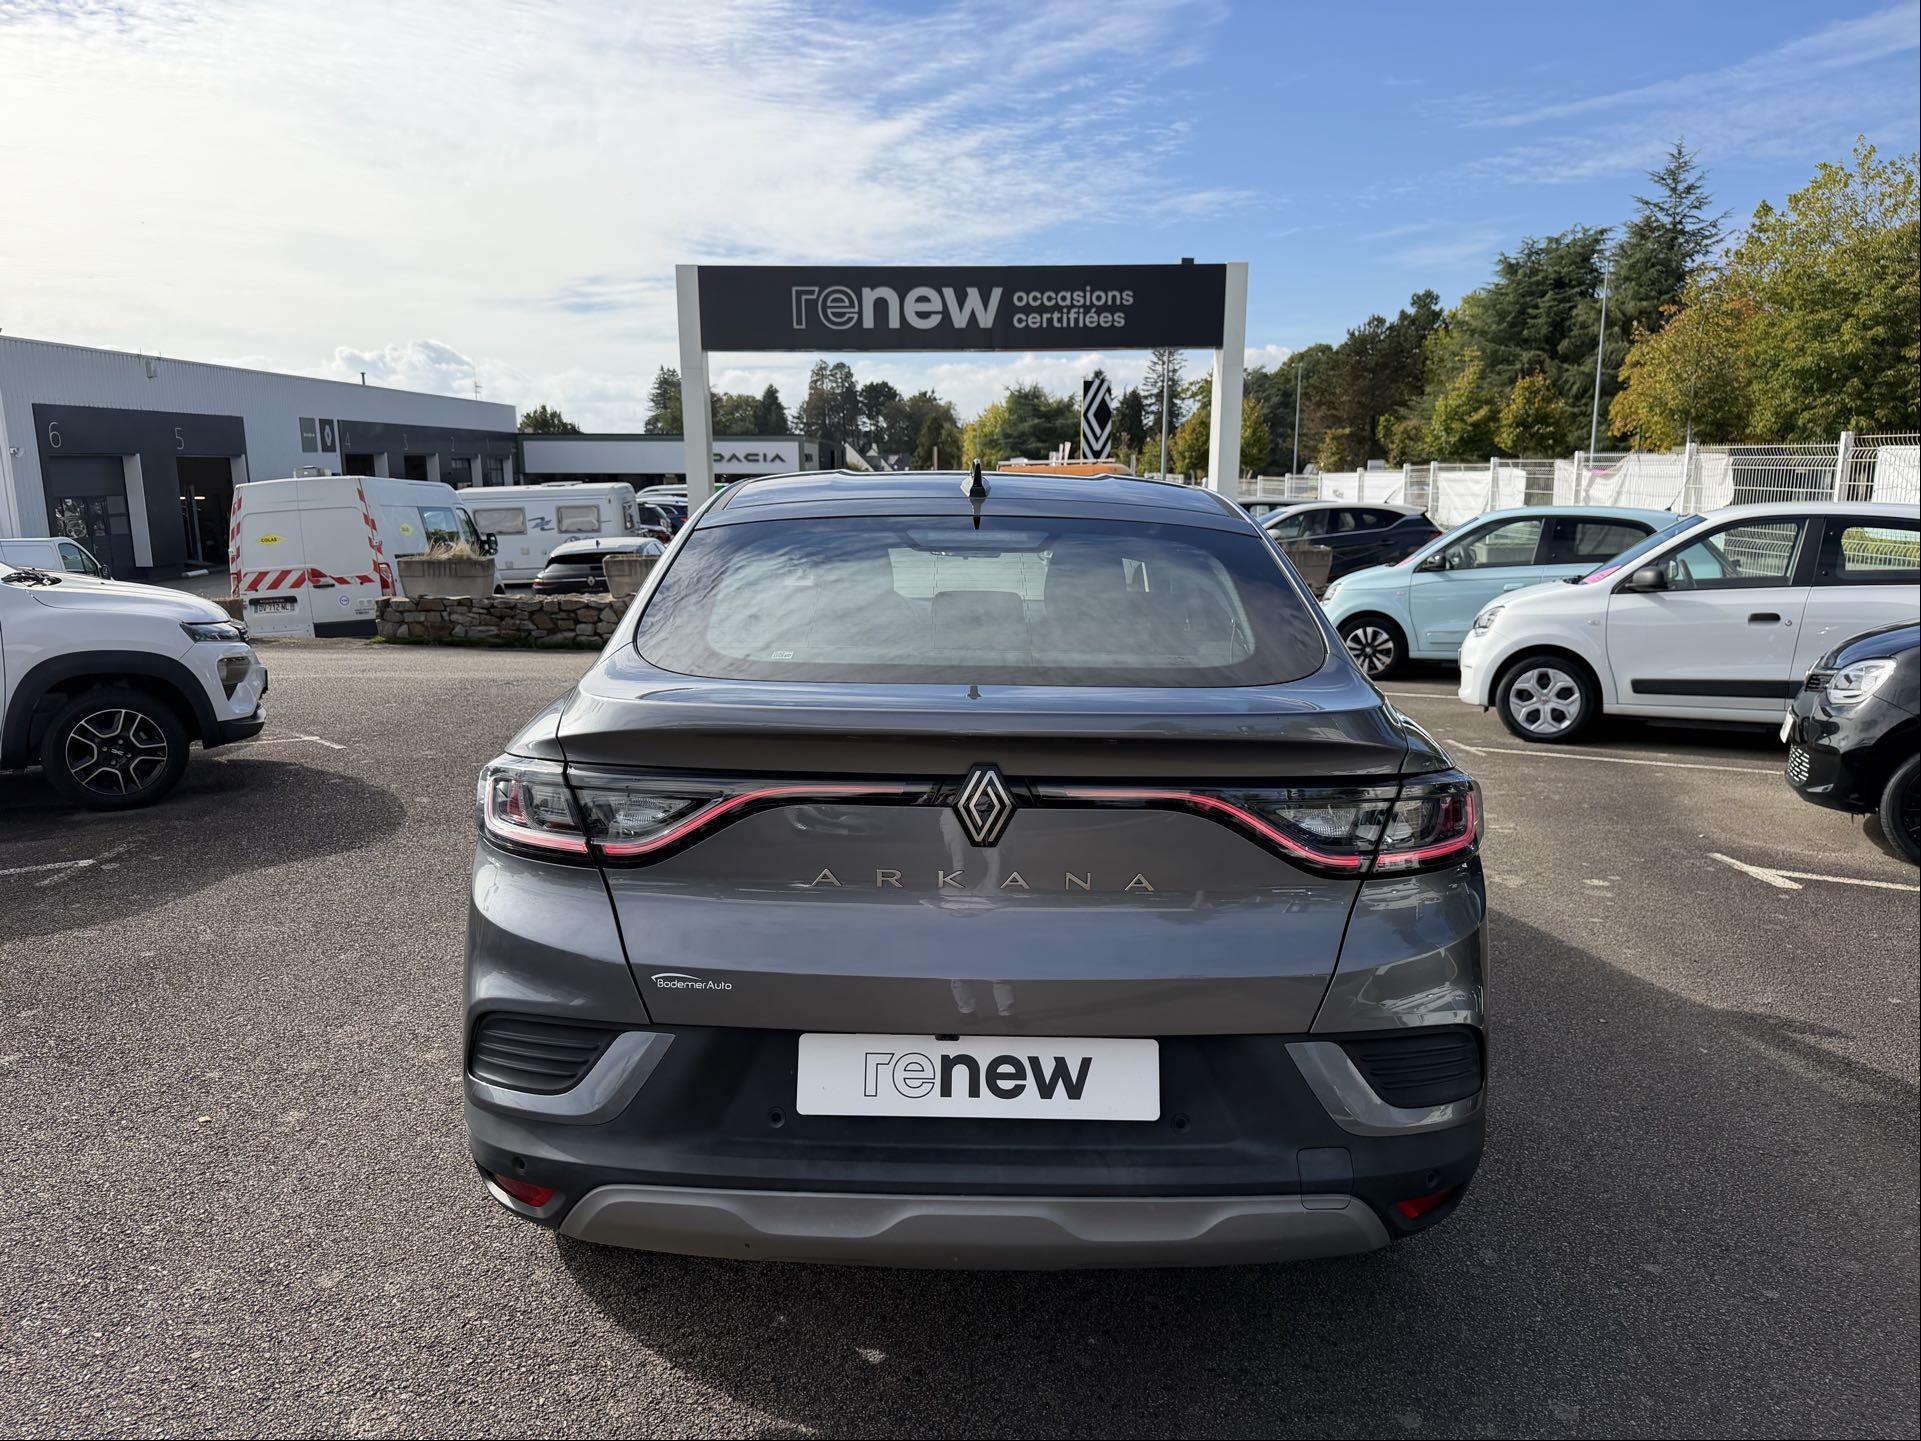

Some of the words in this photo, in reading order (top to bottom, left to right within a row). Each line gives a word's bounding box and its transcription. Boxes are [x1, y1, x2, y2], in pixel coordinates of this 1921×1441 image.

[792, 286, 1003, 329] renew
[1012, 286, 1135, 307] occasions
[1012, 308, 1126, 328] certifiées
[48, 421, 62, 448] 6
[174, 427, 185, 450] 5
[344, 431, 351, 449] 4
[811, 868, 1155, 891] ARKANA
[864, 1052, 1093, 1100] renew
